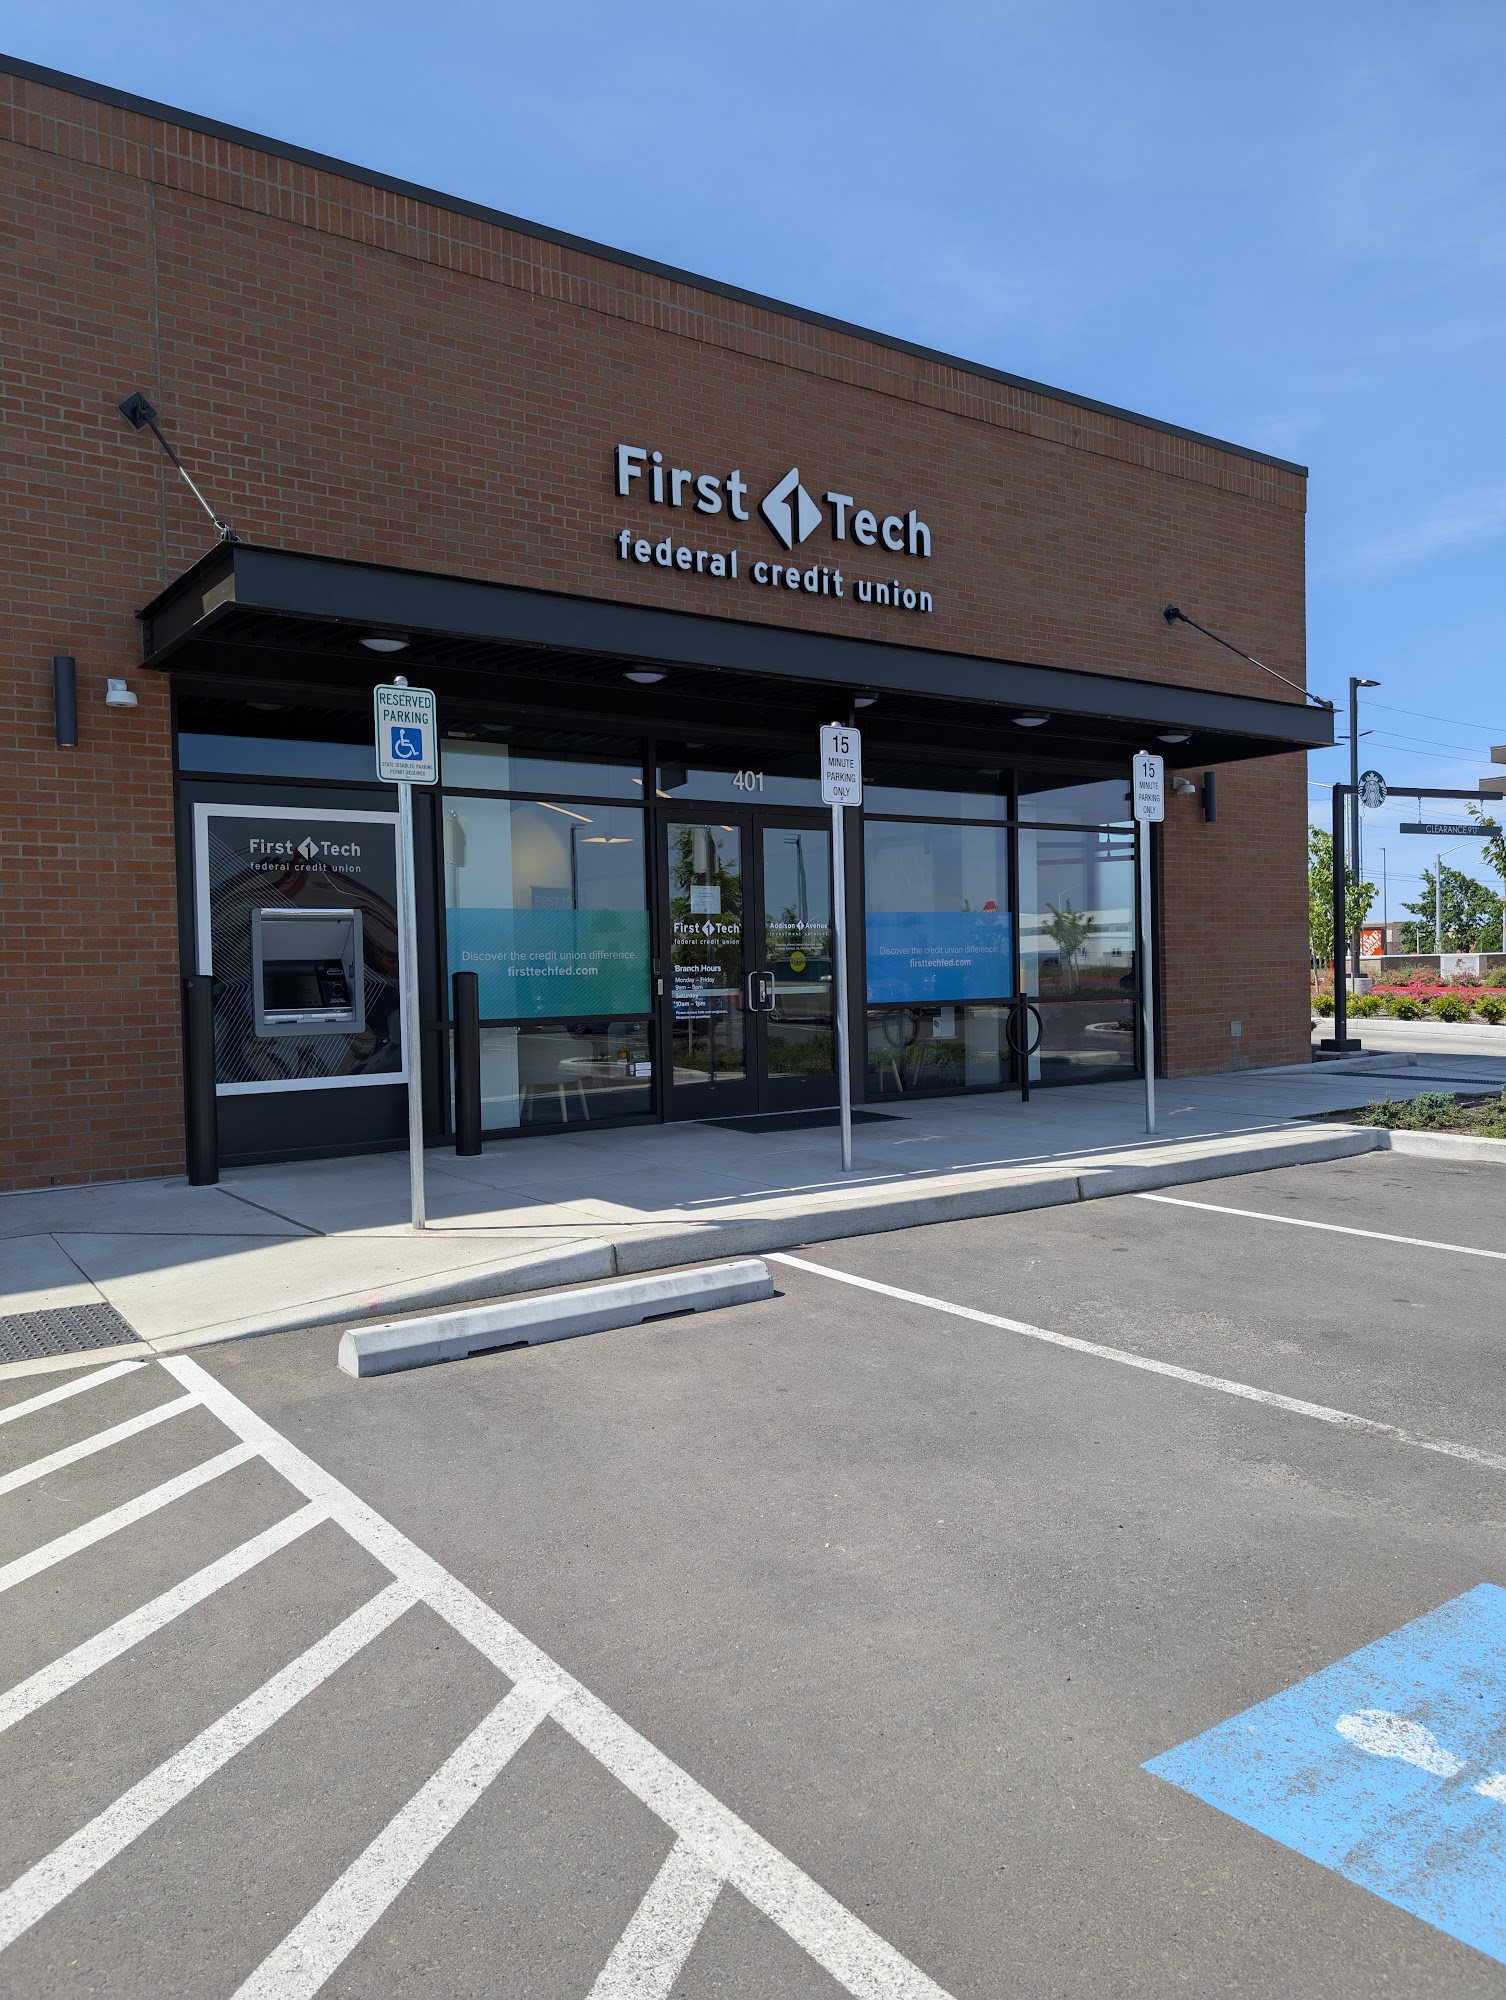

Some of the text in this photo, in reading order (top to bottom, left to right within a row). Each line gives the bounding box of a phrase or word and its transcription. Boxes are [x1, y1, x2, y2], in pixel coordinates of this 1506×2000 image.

[615, 444, 932, 558] First Tech
[616, 529, 933, 613] federal credit union
[379, 692, 431, 709] RESERVED
[383, 709, 429, 725] PARKING
[833, 735, 849, 754] 15
[828, 757, 855, 768] MINUTE
[1142, 762, 1155, 778] 15
[731, 770, 764, 792] 401
[826, 771, 856, 783] PARKING
[1139, 781, 1159, 790] MINUTE
[833, 786, 851, 797] ONLY
[1138, 793, 1160, 802] PARKING
[1143, 805, 1156, 814] ONLY
[1425, 824, 1467, 834] CLEARANCE
[249, 838, 361, 857] First Tech
[250, 861, 361, 873] federal credit union
[673, 922, 700, 933] First
[462, 950, 638, 961] Discover the credit union difference.
[879, 945, 999, 955] Discover the credit union difference.
[674, 964, 722, 972] Branch Hours
[909, 958, 971, 968] firsttechfed.com
[508, 966, 598, 977] firsttechfed.com
